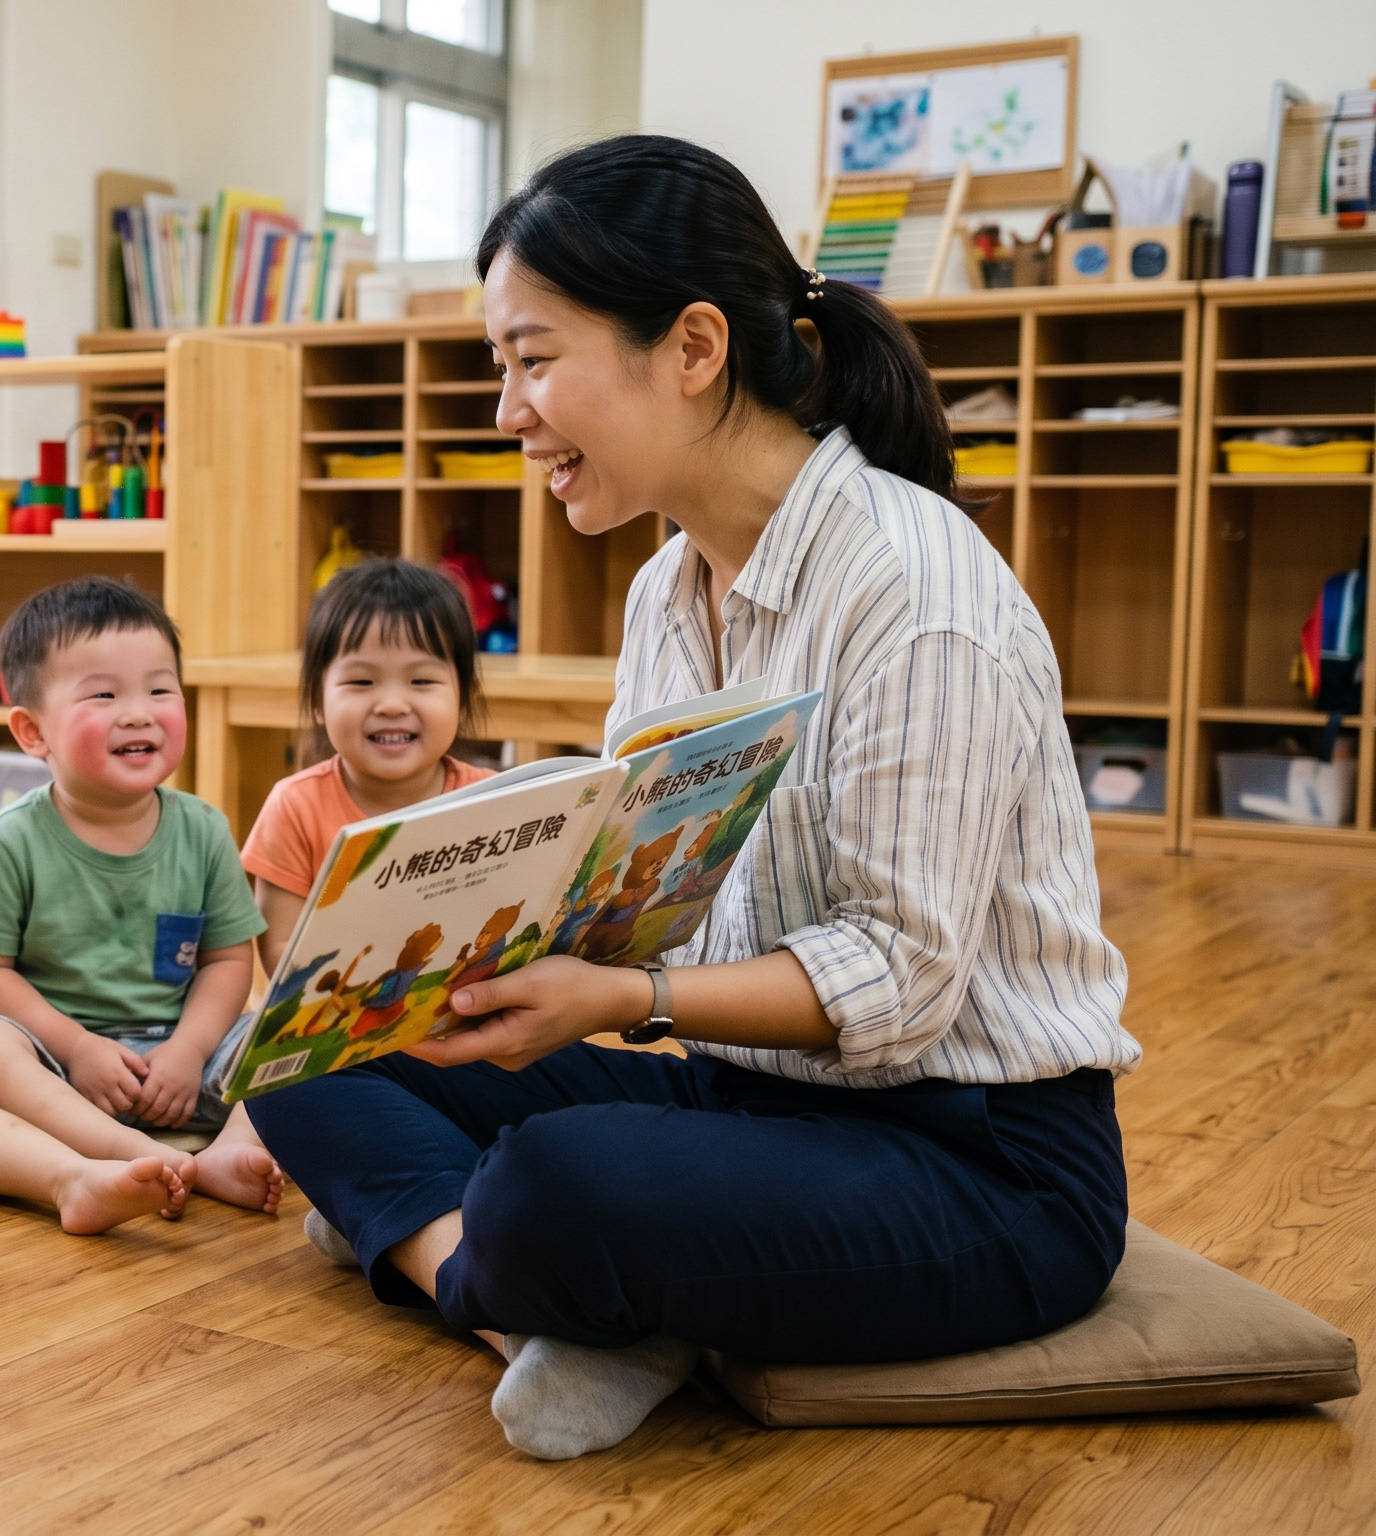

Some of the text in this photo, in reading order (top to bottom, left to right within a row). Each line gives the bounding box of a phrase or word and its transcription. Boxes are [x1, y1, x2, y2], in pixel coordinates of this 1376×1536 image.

[622, 735, 785, 813] 小熊的奇幻冒險
[374, 813, 568, 890] 小熊的奇幻冒險
